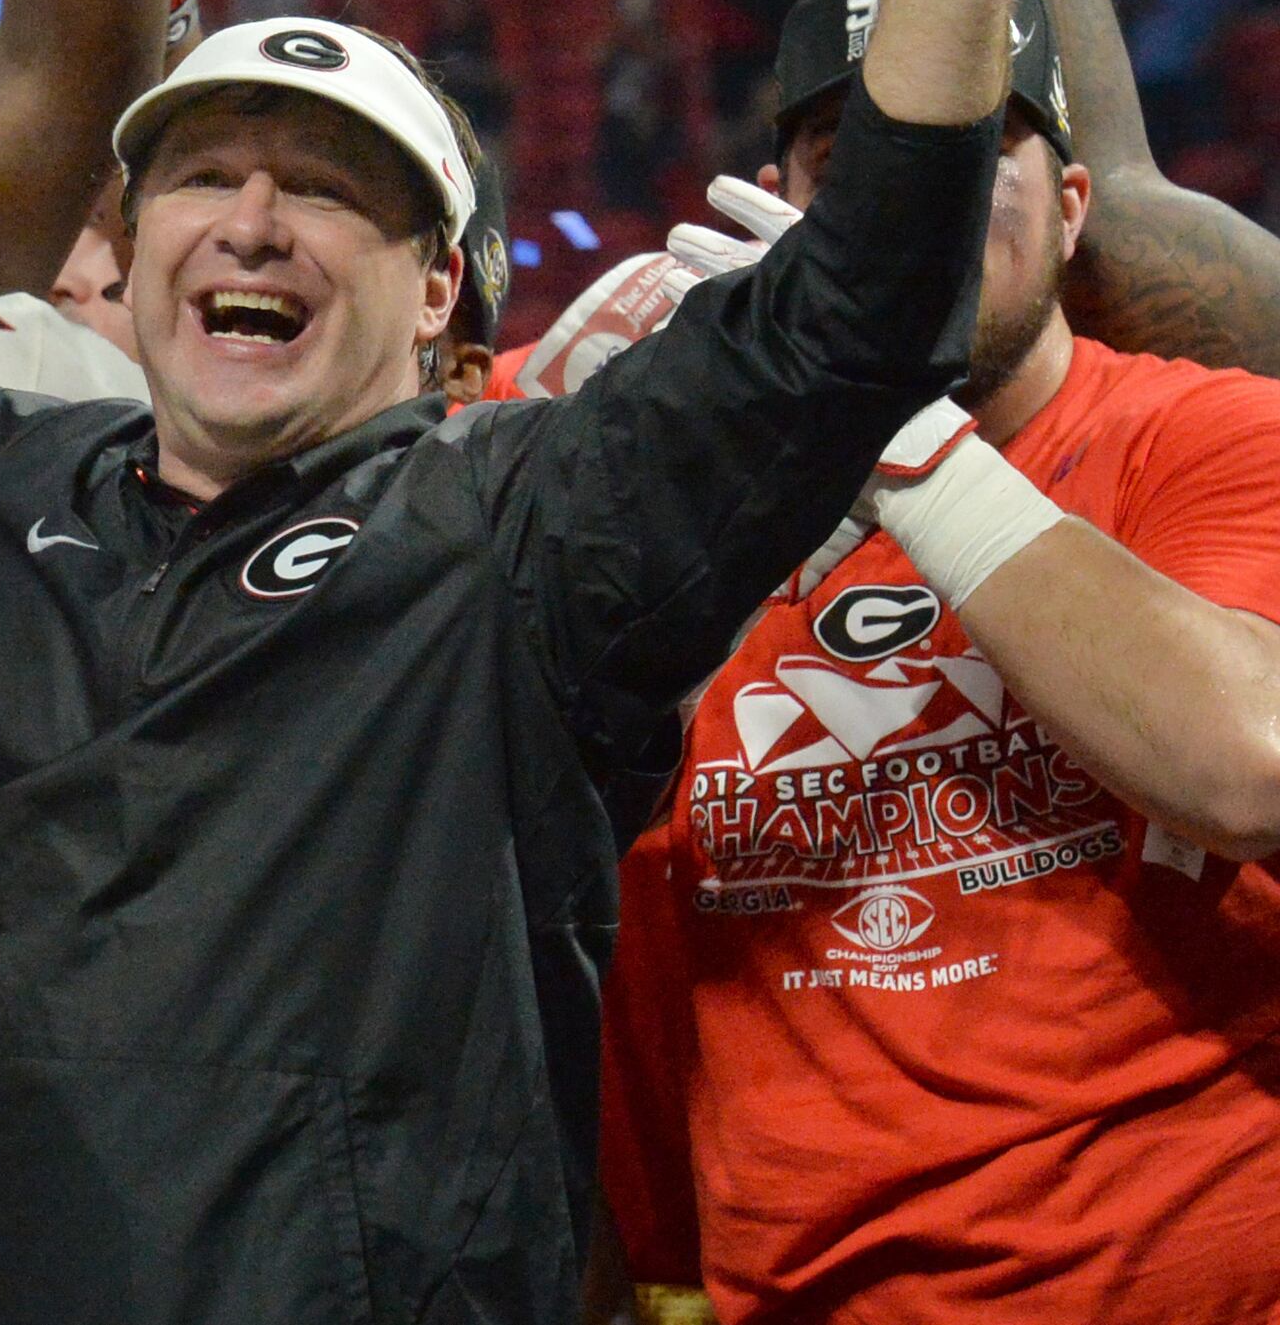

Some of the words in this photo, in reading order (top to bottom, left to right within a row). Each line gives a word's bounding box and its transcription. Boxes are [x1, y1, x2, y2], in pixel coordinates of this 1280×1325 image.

[690, 771, 755, 800] 017
[776, 769, 845, 800] SEC
[957, 829, 1123, 895] BULLDOGS
[861, 896, 907, 947] SEC
[826, 947, 942, 964] CHAMPIONSHIP
[783, 971, 805, 990] IT
[808, 969, 843, 987] JUST
[849, 969, 926, 991] MEANS
